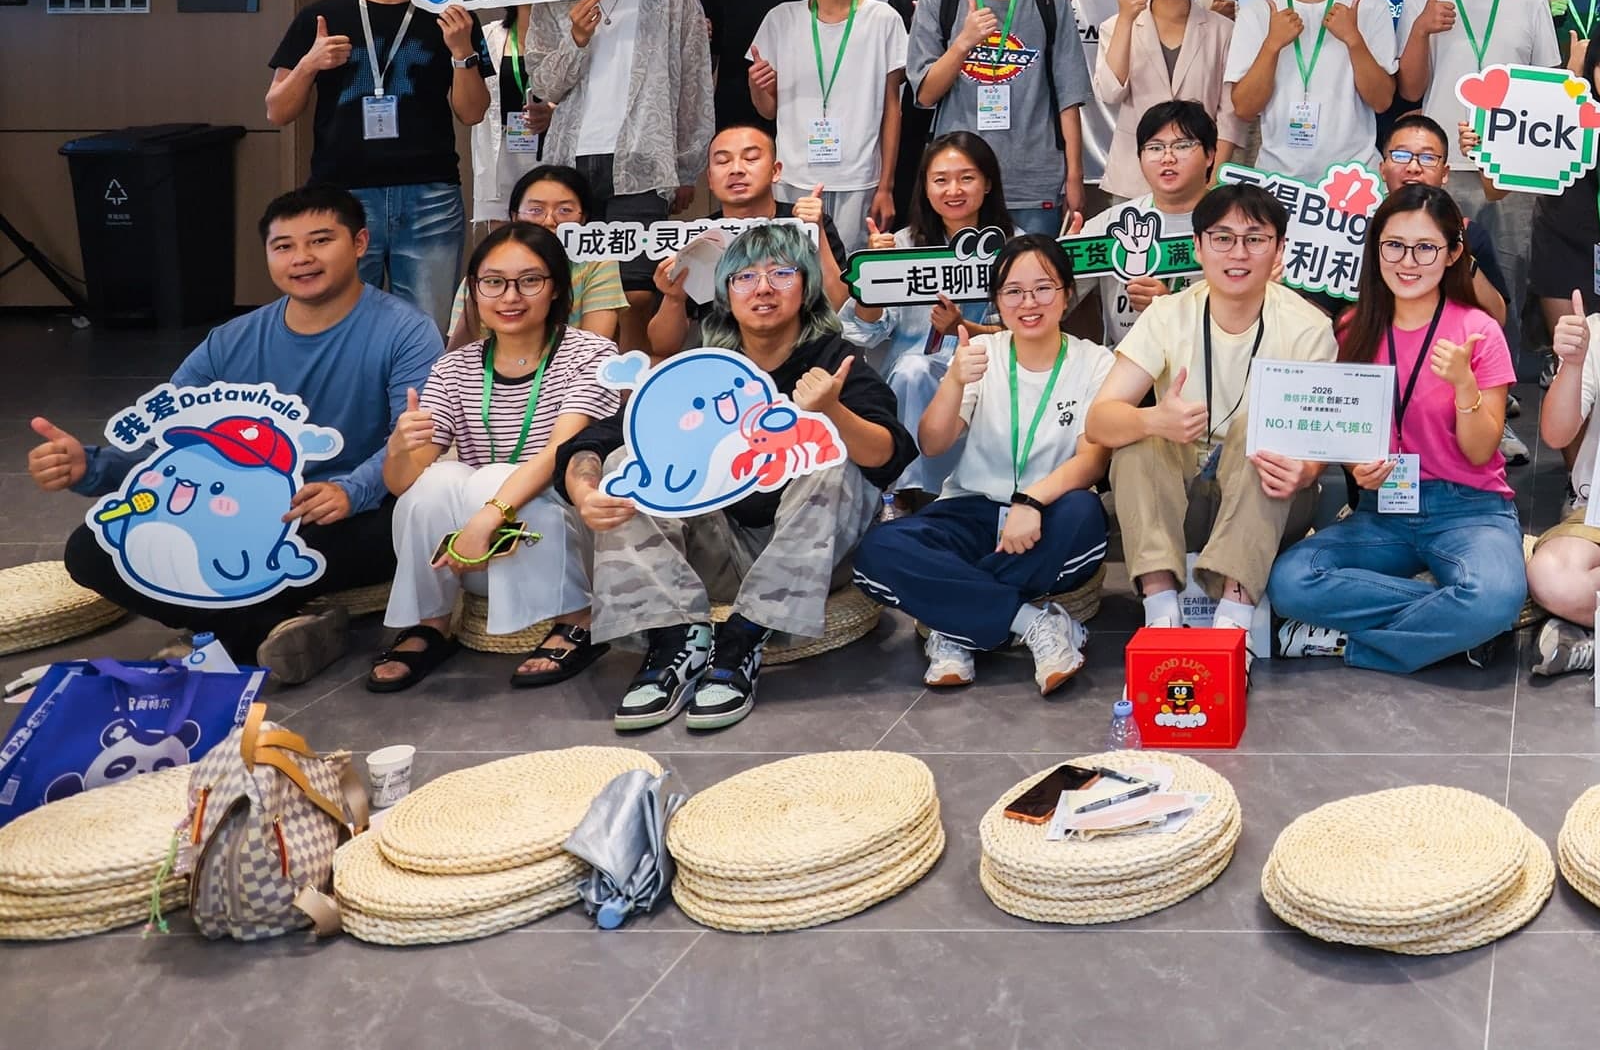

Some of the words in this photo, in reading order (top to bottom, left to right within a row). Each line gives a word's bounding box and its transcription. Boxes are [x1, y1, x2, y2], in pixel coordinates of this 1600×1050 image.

[1487, 107, 1578, 151] Pick
[1312, 386, 1333, 395] 2026
[1326, 395, 1359, 406] 创新工坊
[1265, 418, 1293, 430] NO.1
[1297, 419, 1373, 434] 最佳人气摊位
[1149, 658, 1179, 682] GOOD
